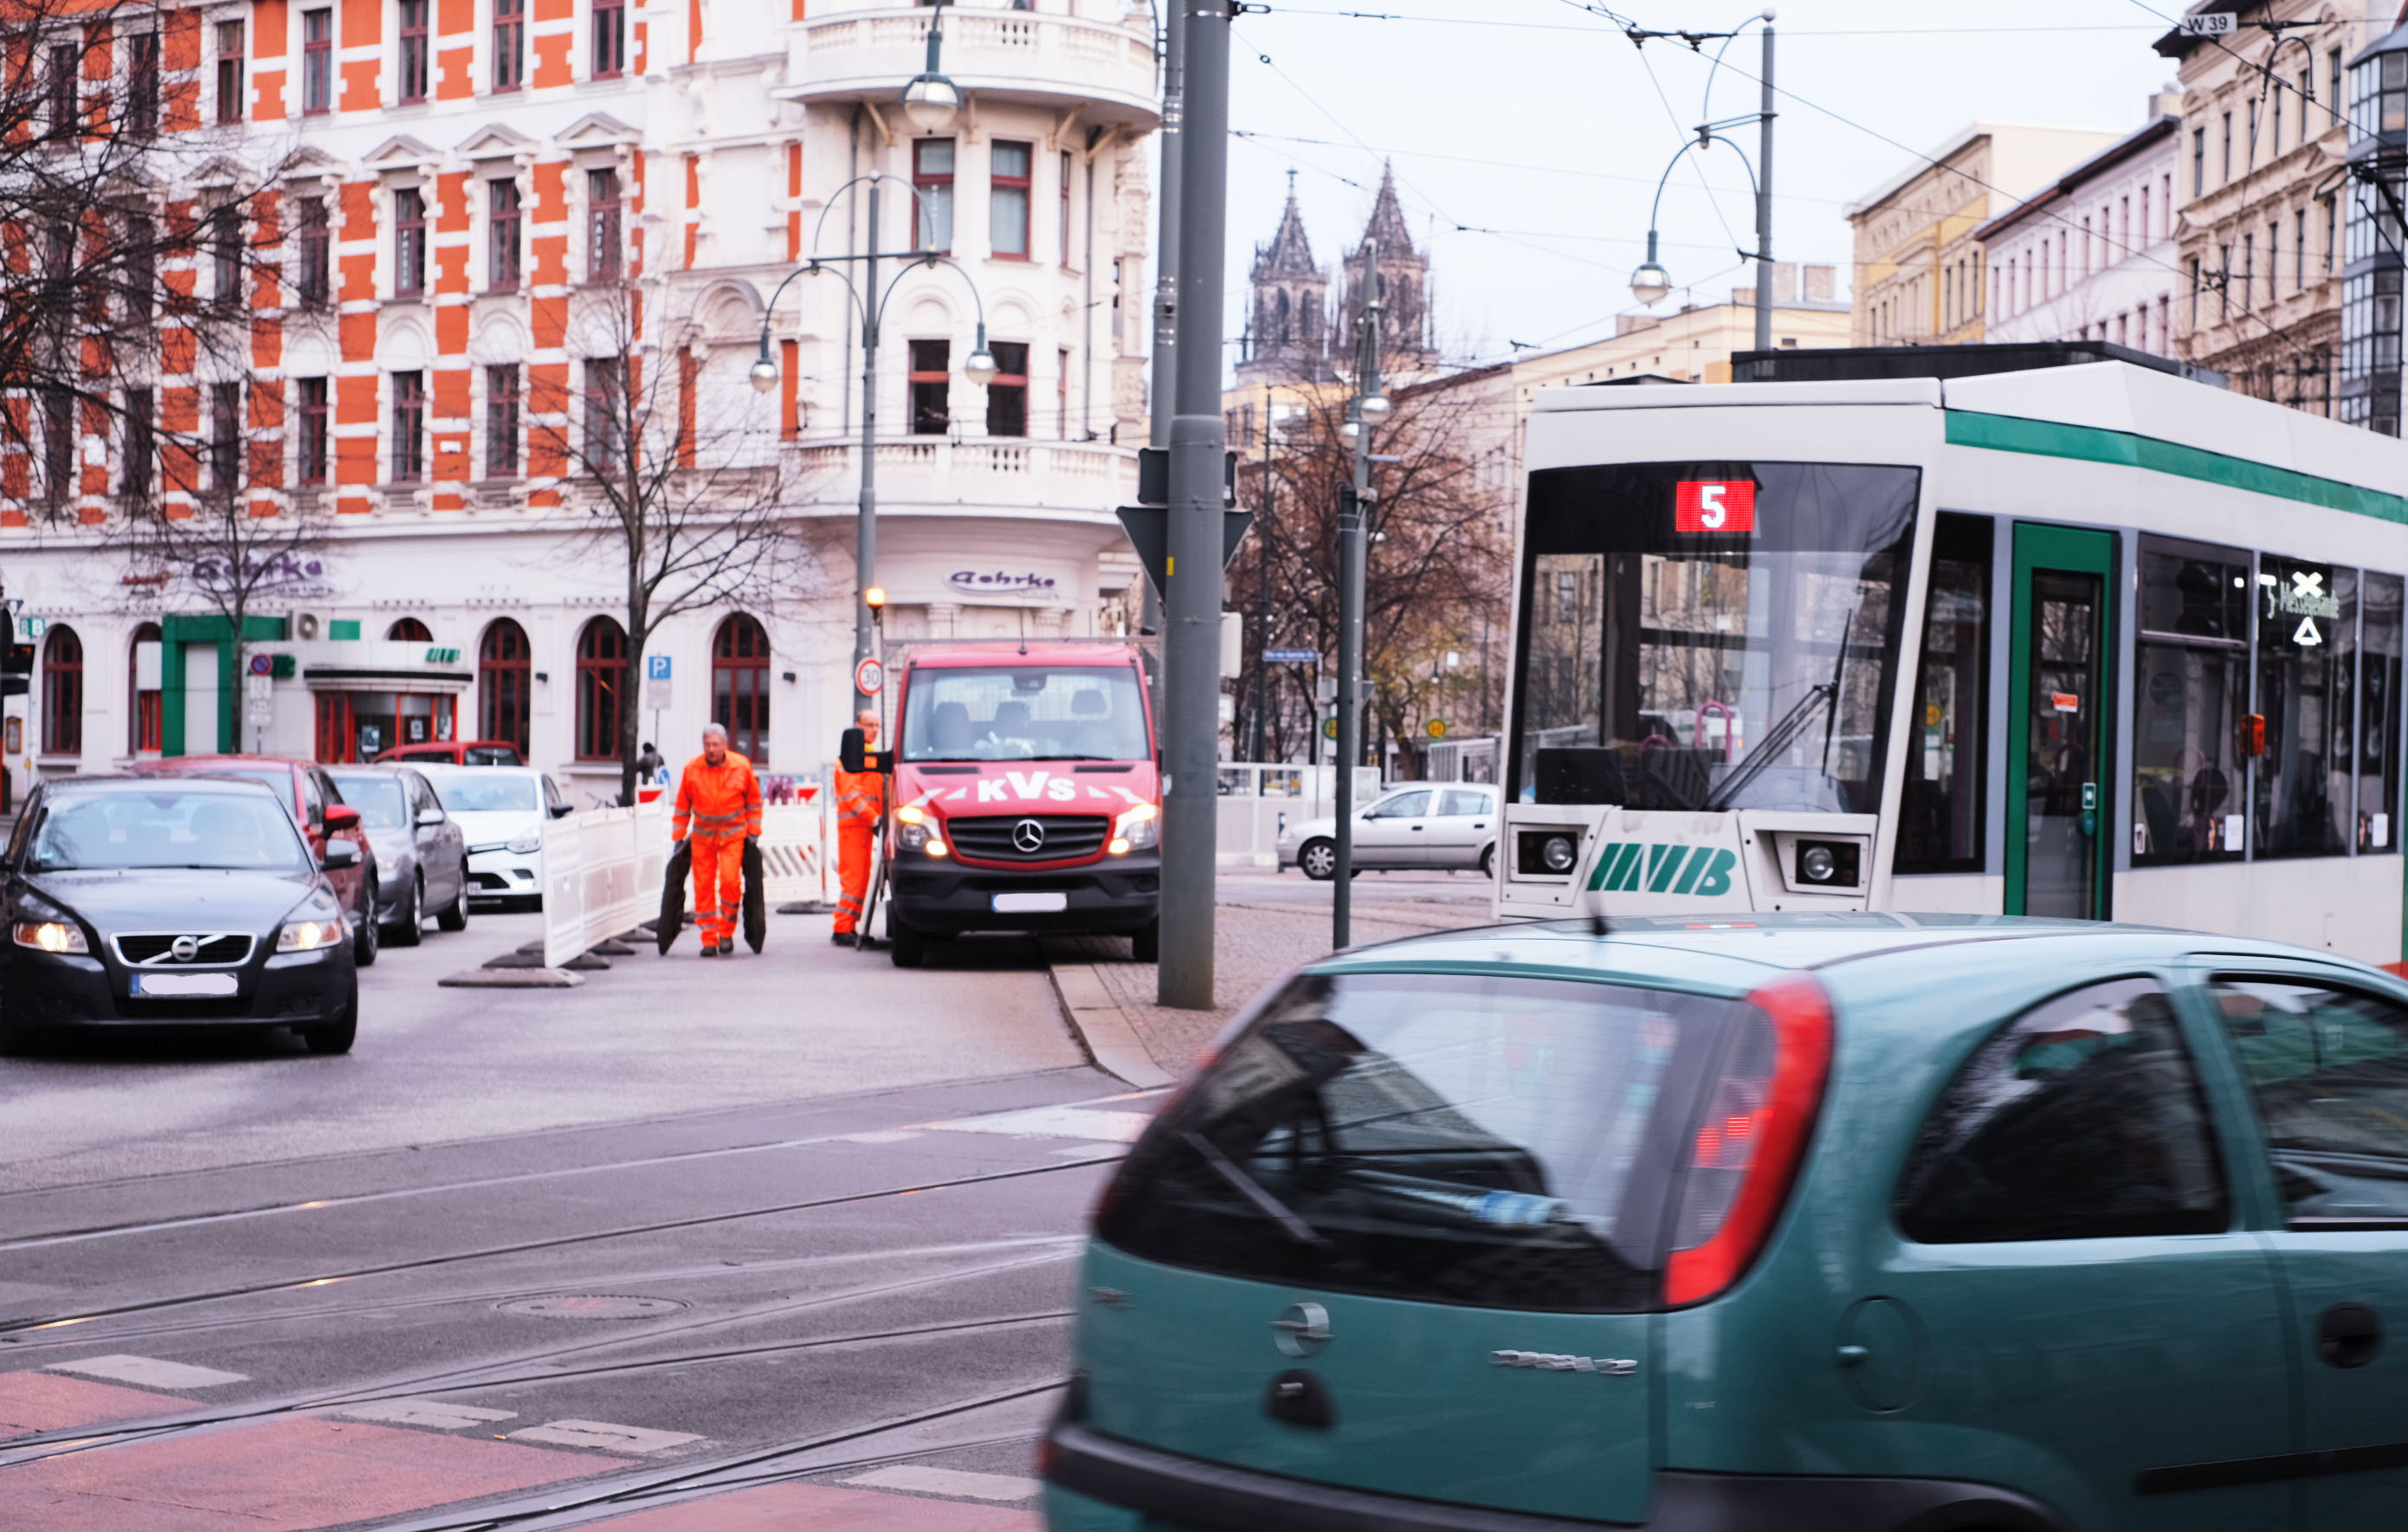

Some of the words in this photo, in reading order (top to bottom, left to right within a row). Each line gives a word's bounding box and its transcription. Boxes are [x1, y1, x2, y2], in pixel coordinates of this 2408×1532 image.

[2187, 17, 2205, 31] W
[2209, 16, 2228, 31] 39
[1700, 484, 1726, 528] 5
[653, 658, 667, 677] P
[863, 668, 880, 685] 30
[978, 771, 1076, 803] KVS
